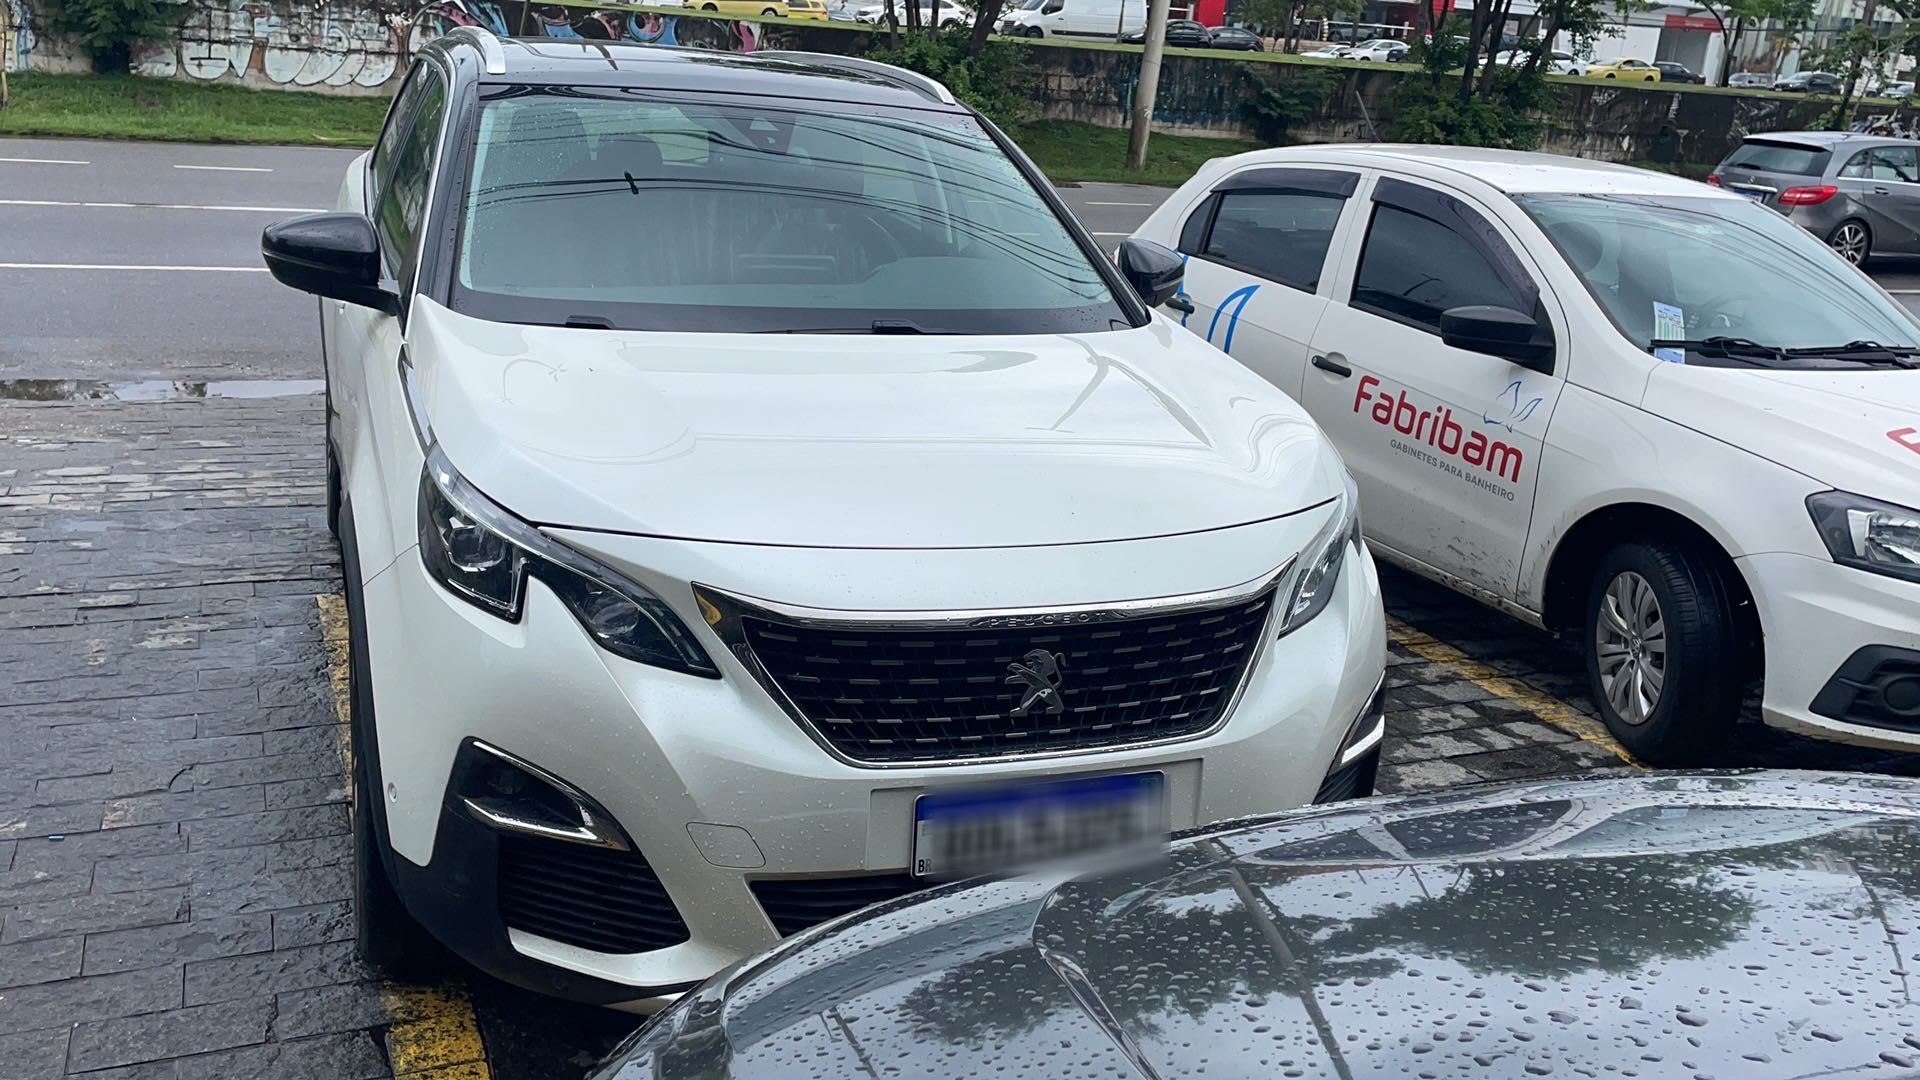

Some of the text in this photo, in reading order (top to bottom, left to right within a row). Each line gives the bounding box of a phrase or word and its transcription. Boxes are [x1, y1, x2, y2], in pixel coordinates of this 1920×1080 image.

[1353, 375, 1523, 482] Fabribam
[1390, 439, 1515, 501] GABINETES PARA BANHEIRO
